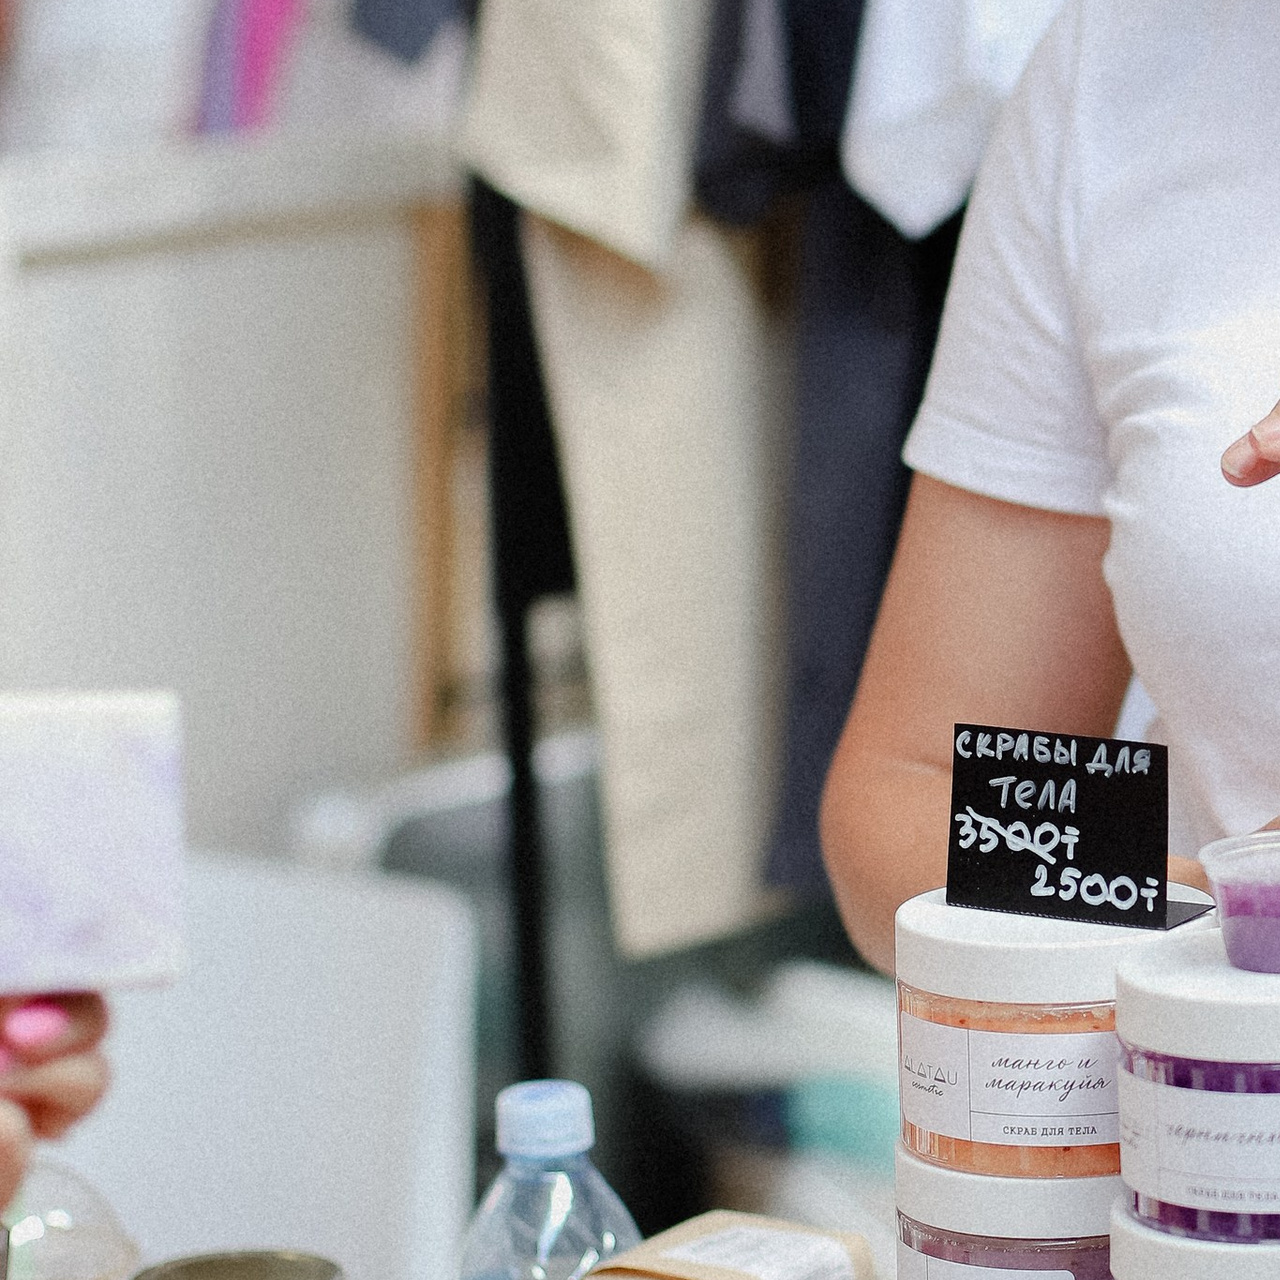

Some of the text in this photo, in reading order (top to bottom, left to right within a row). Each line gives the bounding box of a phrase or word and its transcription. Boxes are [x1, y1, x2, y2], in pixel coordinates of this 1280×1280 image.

[955, 730, 1151, 778] СКРАБЫ ДЛЯ
[991, 1056, 1099, 1071] манго и
[985, 1074, 1112, 1102] маракуйя
[1002, 1125, 1098, 1137] СКРАБ ДЛЯ ТЕЛА
